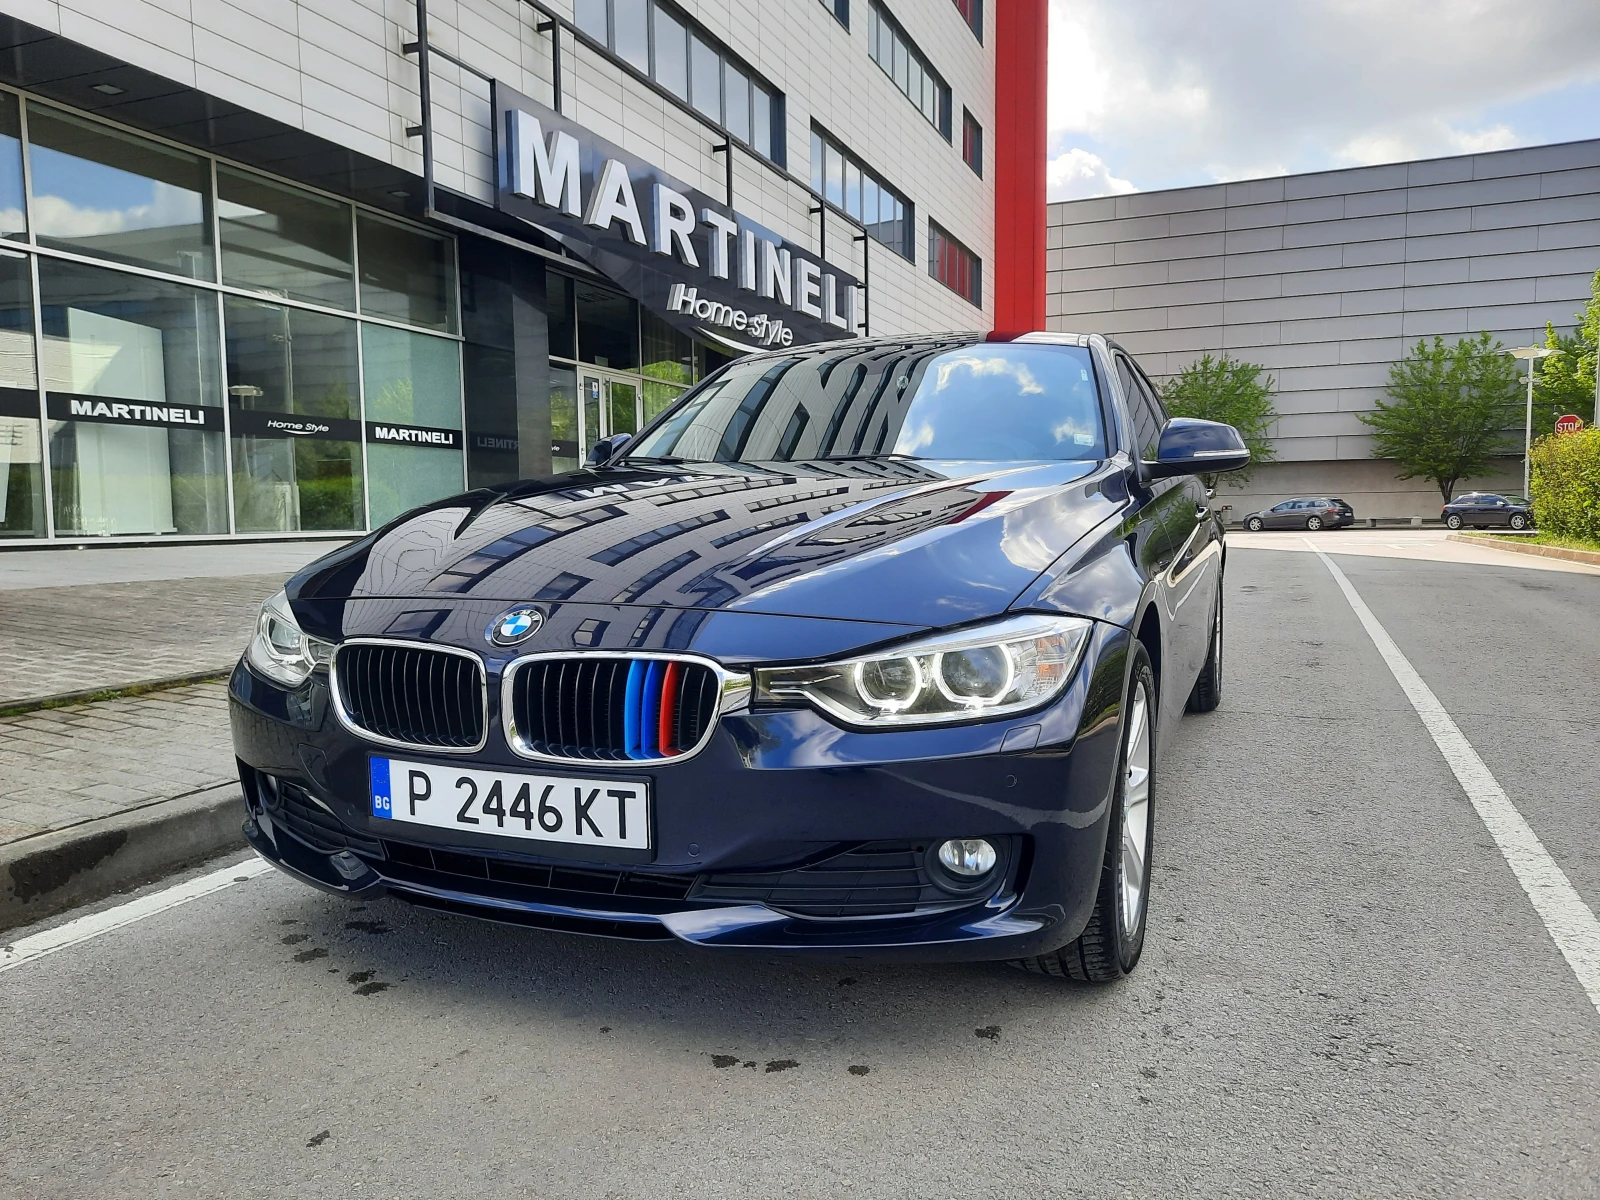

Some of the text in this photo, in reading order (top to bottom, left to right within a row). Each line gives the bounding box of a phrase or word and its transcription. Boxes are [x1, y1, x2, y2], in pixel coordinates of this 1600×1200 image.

[505, 108, 859, 334] MARTINELI
[666, 283, 747, 331] Home
[70, 399, 205, 425] MARTINELI
[267, 419, 329, 433] Home Style
[375, 426, 453, 445] MARTINELI
[1557, 422, 1581, 432] STOP
[374, 795, 390, 810] BG
[408, 769, 637, 840] P 2446 KT
